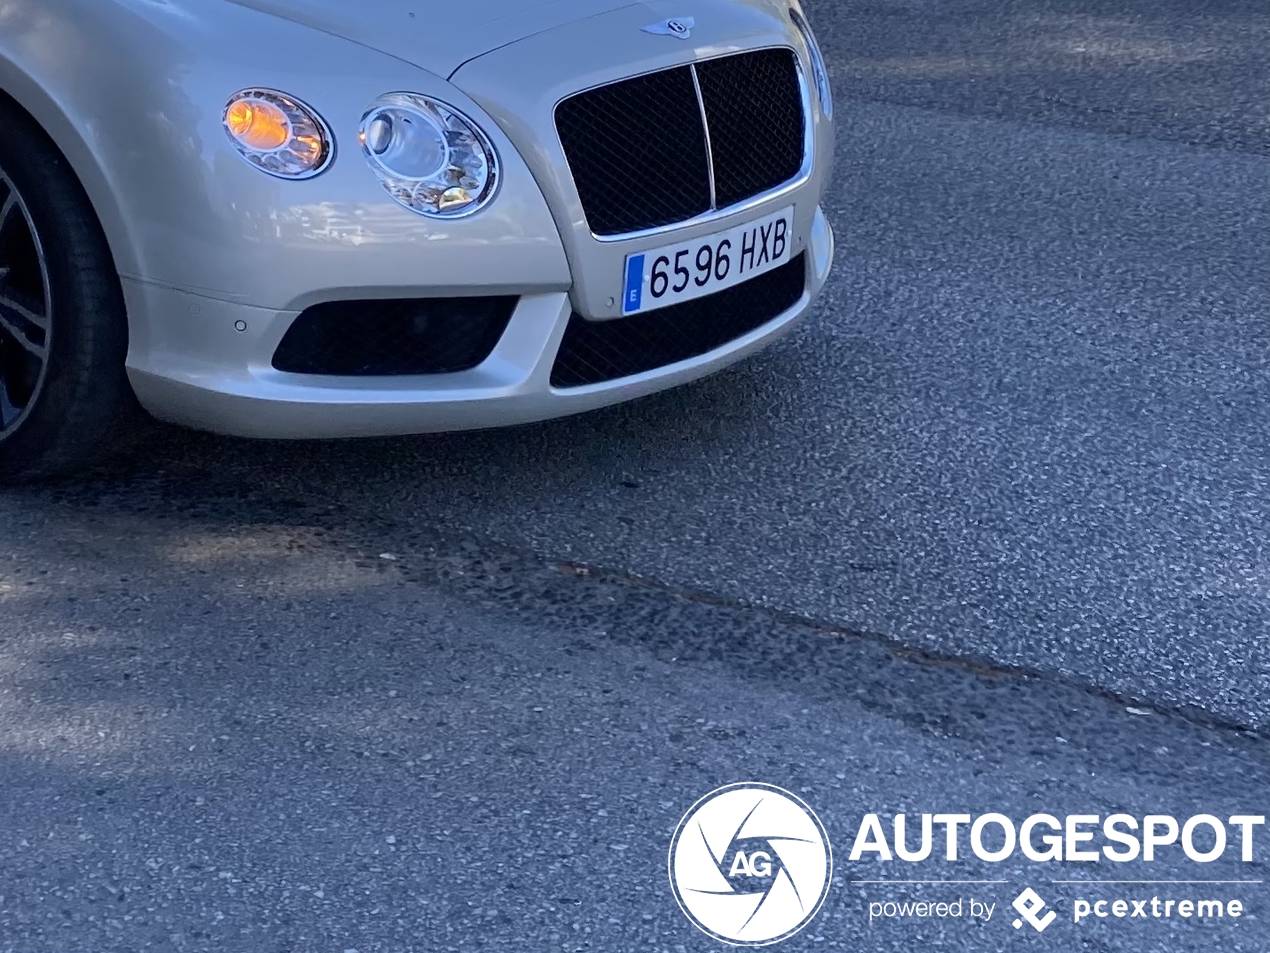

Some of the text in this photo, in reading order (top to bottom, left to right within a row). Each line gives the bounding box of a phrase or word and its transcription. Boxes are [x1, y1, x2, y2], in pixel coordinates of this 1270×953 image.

[650, 218, 787, 298] 6596 HXB
[630, 289, 638, 302] E
